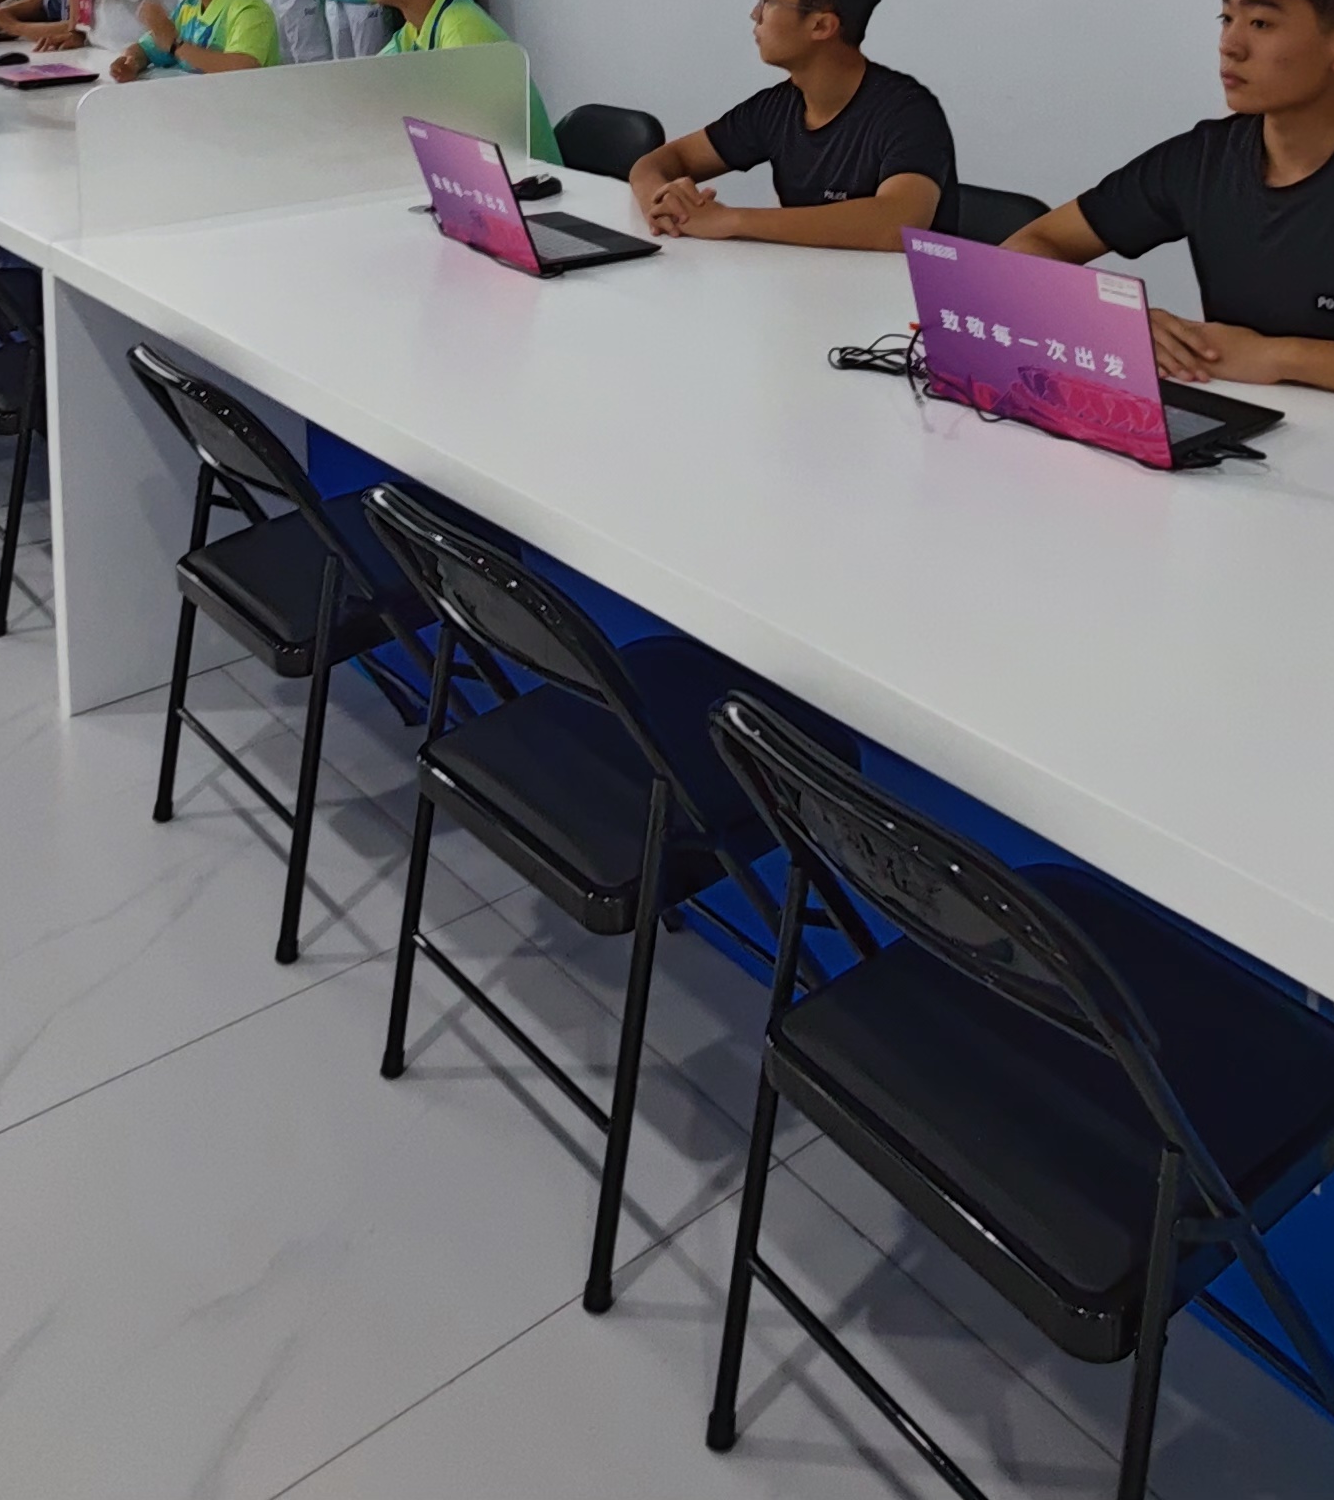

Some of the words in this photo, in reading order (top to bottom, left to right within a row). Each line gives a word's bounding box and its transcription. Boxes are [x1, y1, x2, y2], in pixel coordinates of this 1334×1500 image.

[939, 307, 1128, 380] 致敬每一次出发
